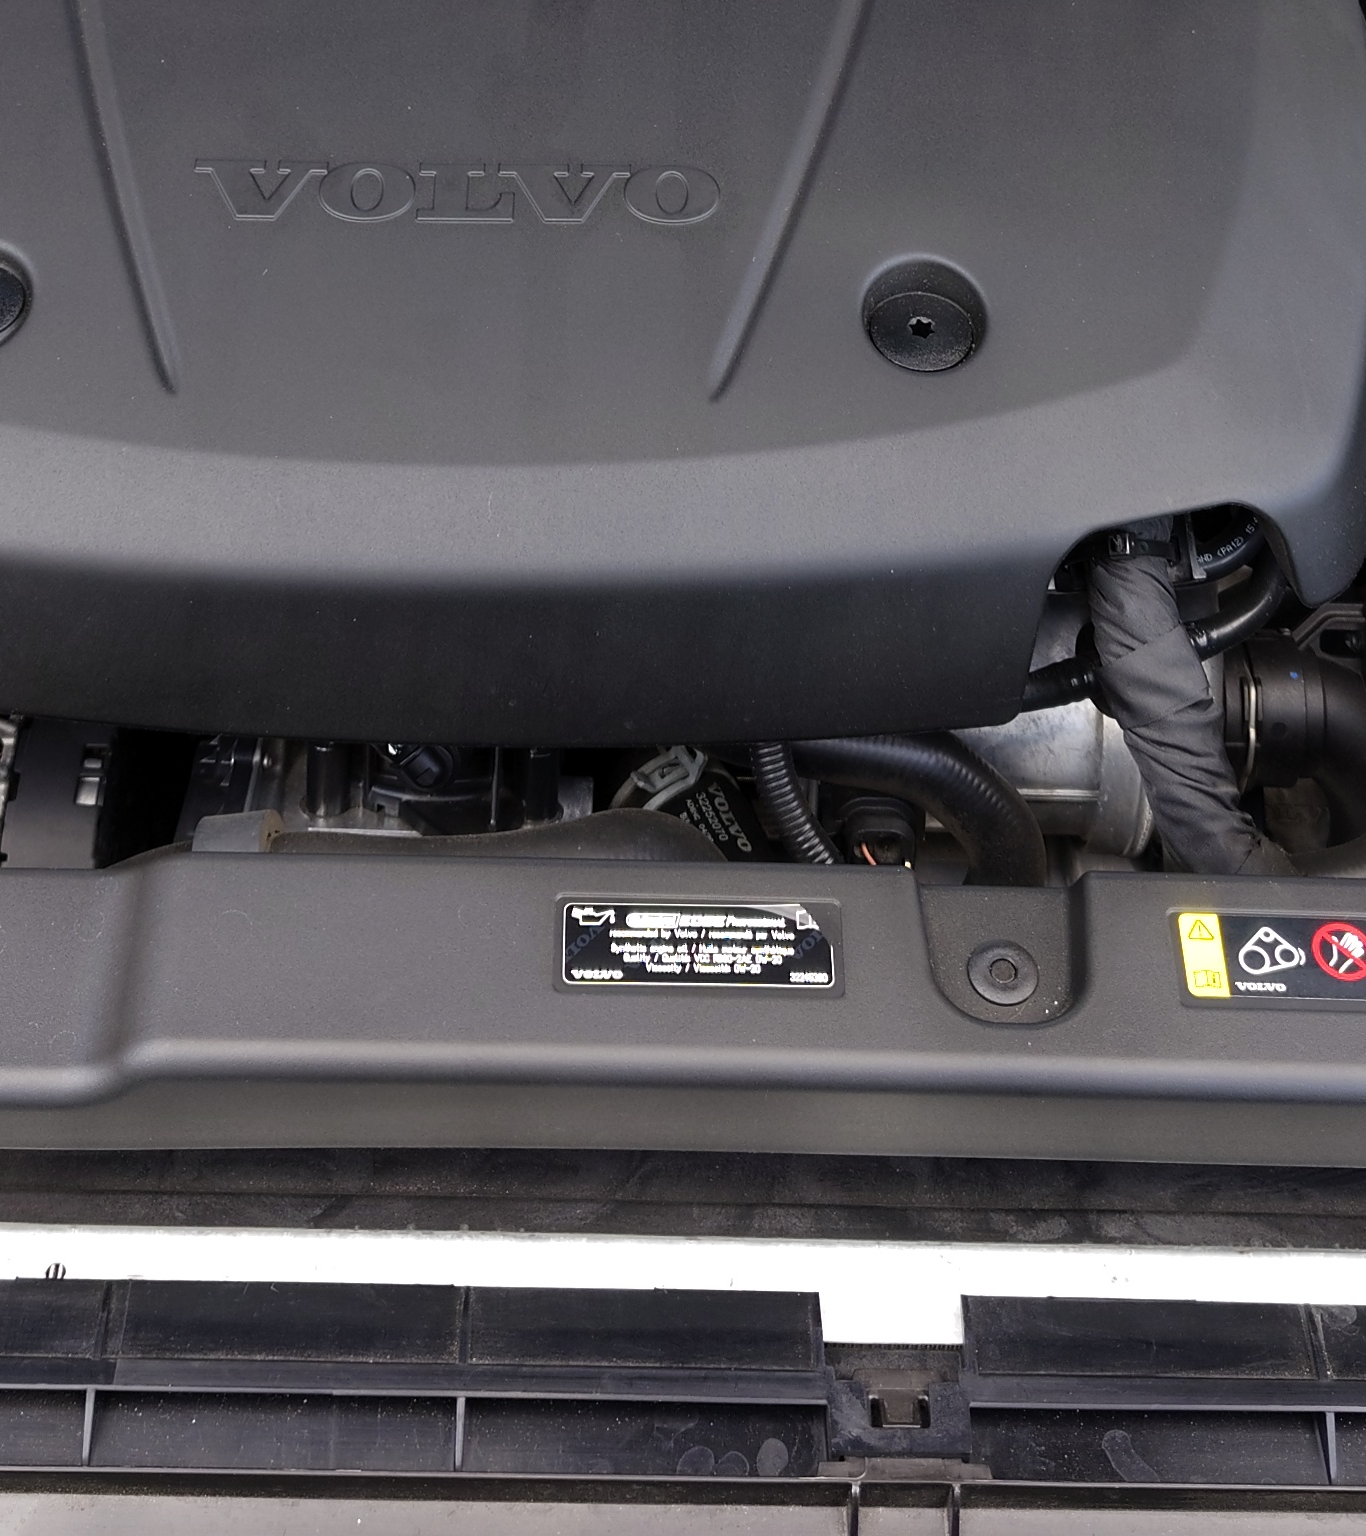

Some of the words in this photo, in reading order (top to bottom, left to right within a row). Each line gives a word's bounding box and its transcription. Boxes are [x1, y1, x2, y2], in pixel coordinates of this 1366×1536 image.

[194, 158, 722, 226] VOLVO
[695, 791, 728, 842] 32252070
[707, 781, 753, 854] VOLVO
[571, 969, 623, 980] VOLVO
[1235, 982, 1286, 992] VOLVO
